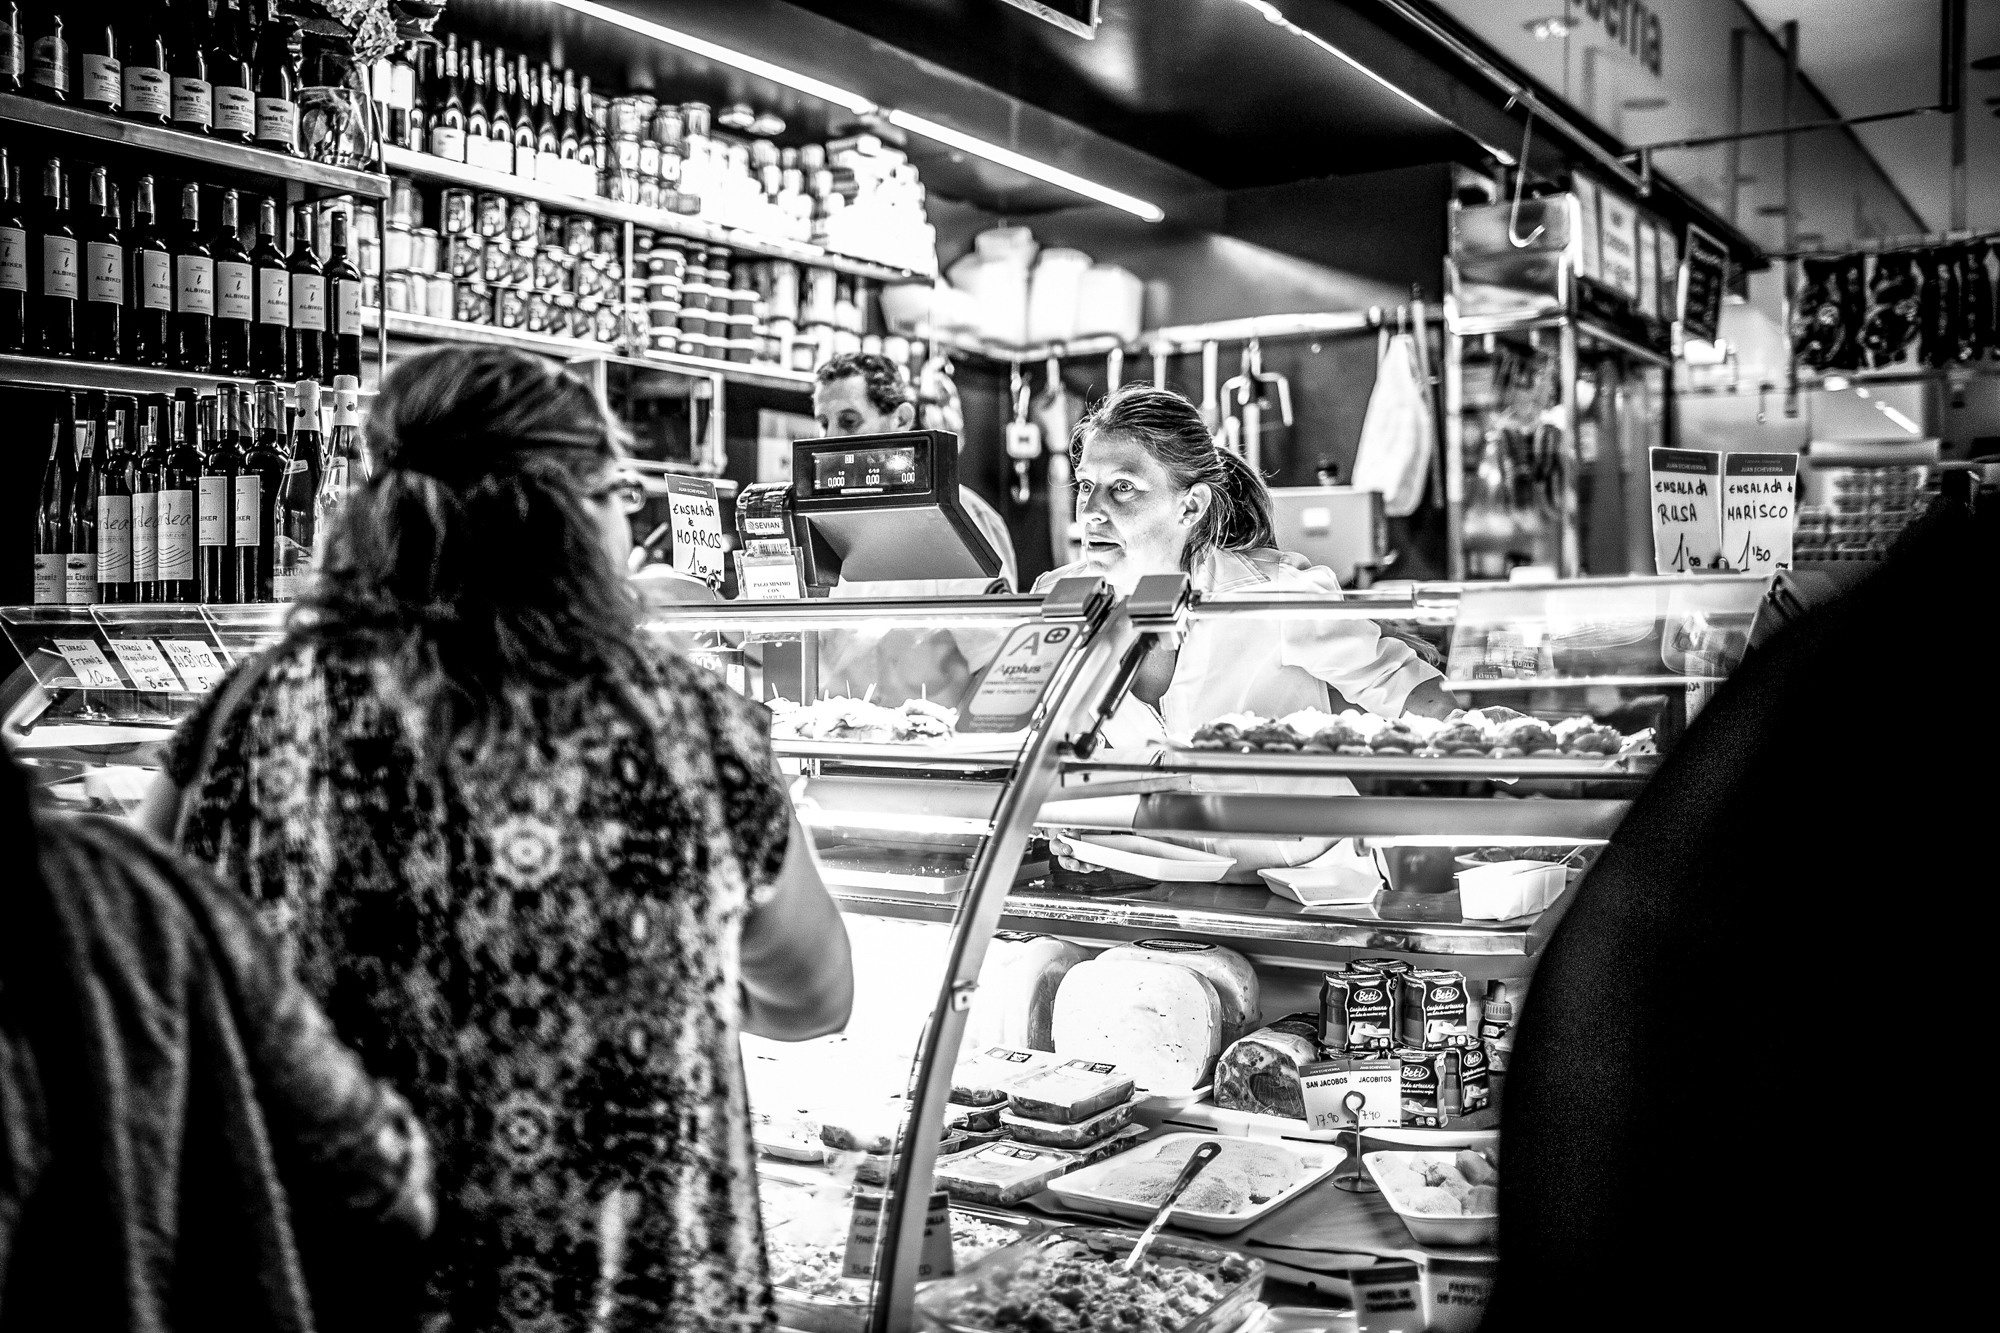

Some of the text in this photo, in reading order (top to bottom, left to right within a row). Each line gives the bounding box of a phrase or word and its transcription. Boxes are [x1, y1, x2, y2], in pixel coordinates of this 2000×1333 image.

[827, 476, 845, 488] 0,000
[866, 474, 880, 486] 0,00
[901, 472, 915, 484] 0,00
[1658, 503, 1697, 525] RUSA
[754, 521, 780, 529] SEVIAN
[677, 529, 722, 549] MORROS
[1358, 990, 1378, 1002] Beti
[1435, 988, 1455, 1000] Beti
[1467, 1052, 1480, 1065] Beti
[1402, 1066, 1425, 1077] Beti
[1320, 1077, 1348, 1087] JACOBOS
[1360, 1110, 1380, 1120] 7.90
